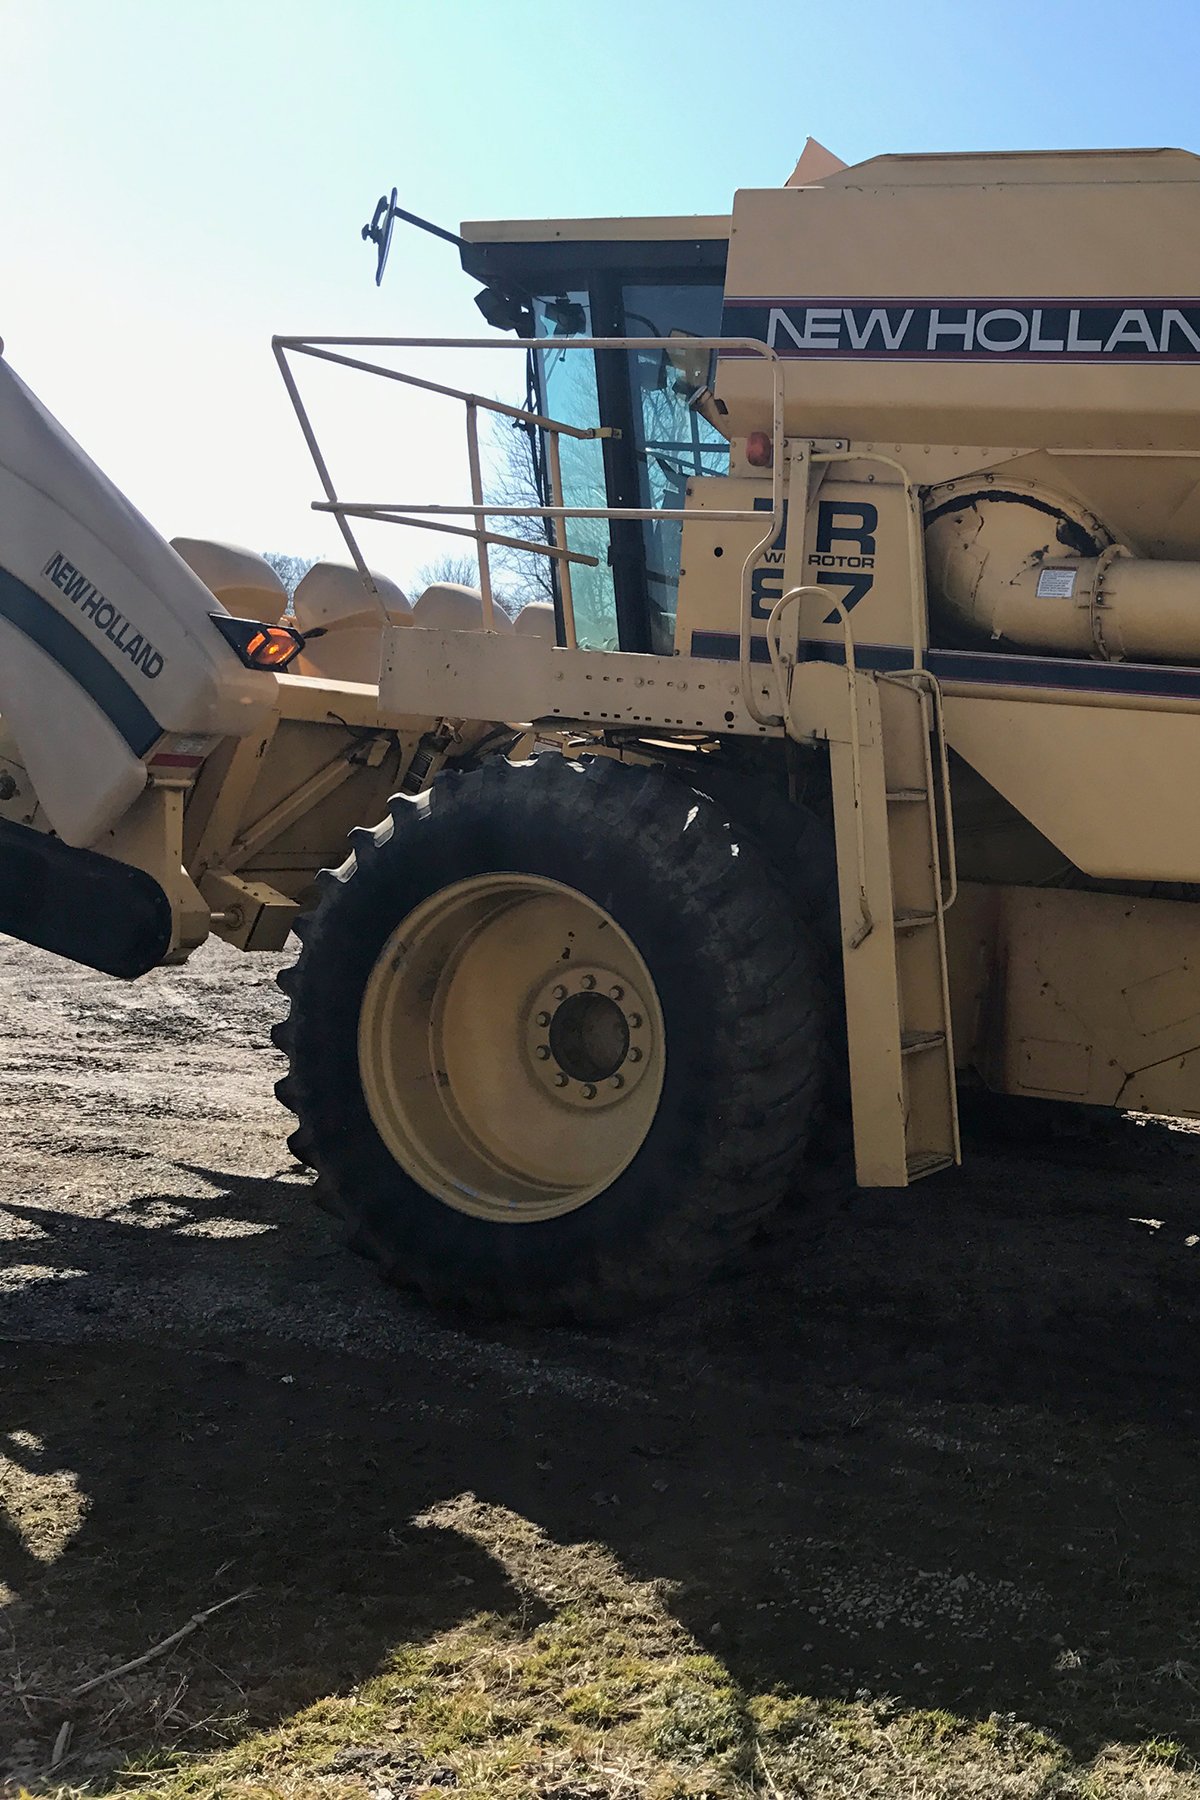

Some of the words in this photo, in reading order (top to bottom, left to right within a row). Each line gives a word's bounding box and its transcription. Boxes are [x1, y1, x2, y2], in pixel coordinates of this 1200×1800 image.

[767, 308, 914, 350] NEW
[808, 554, 875, 569] ROTOR
[45, 554, 92, 604] NEW
[80, 589, 164, 679] HOLLAND
